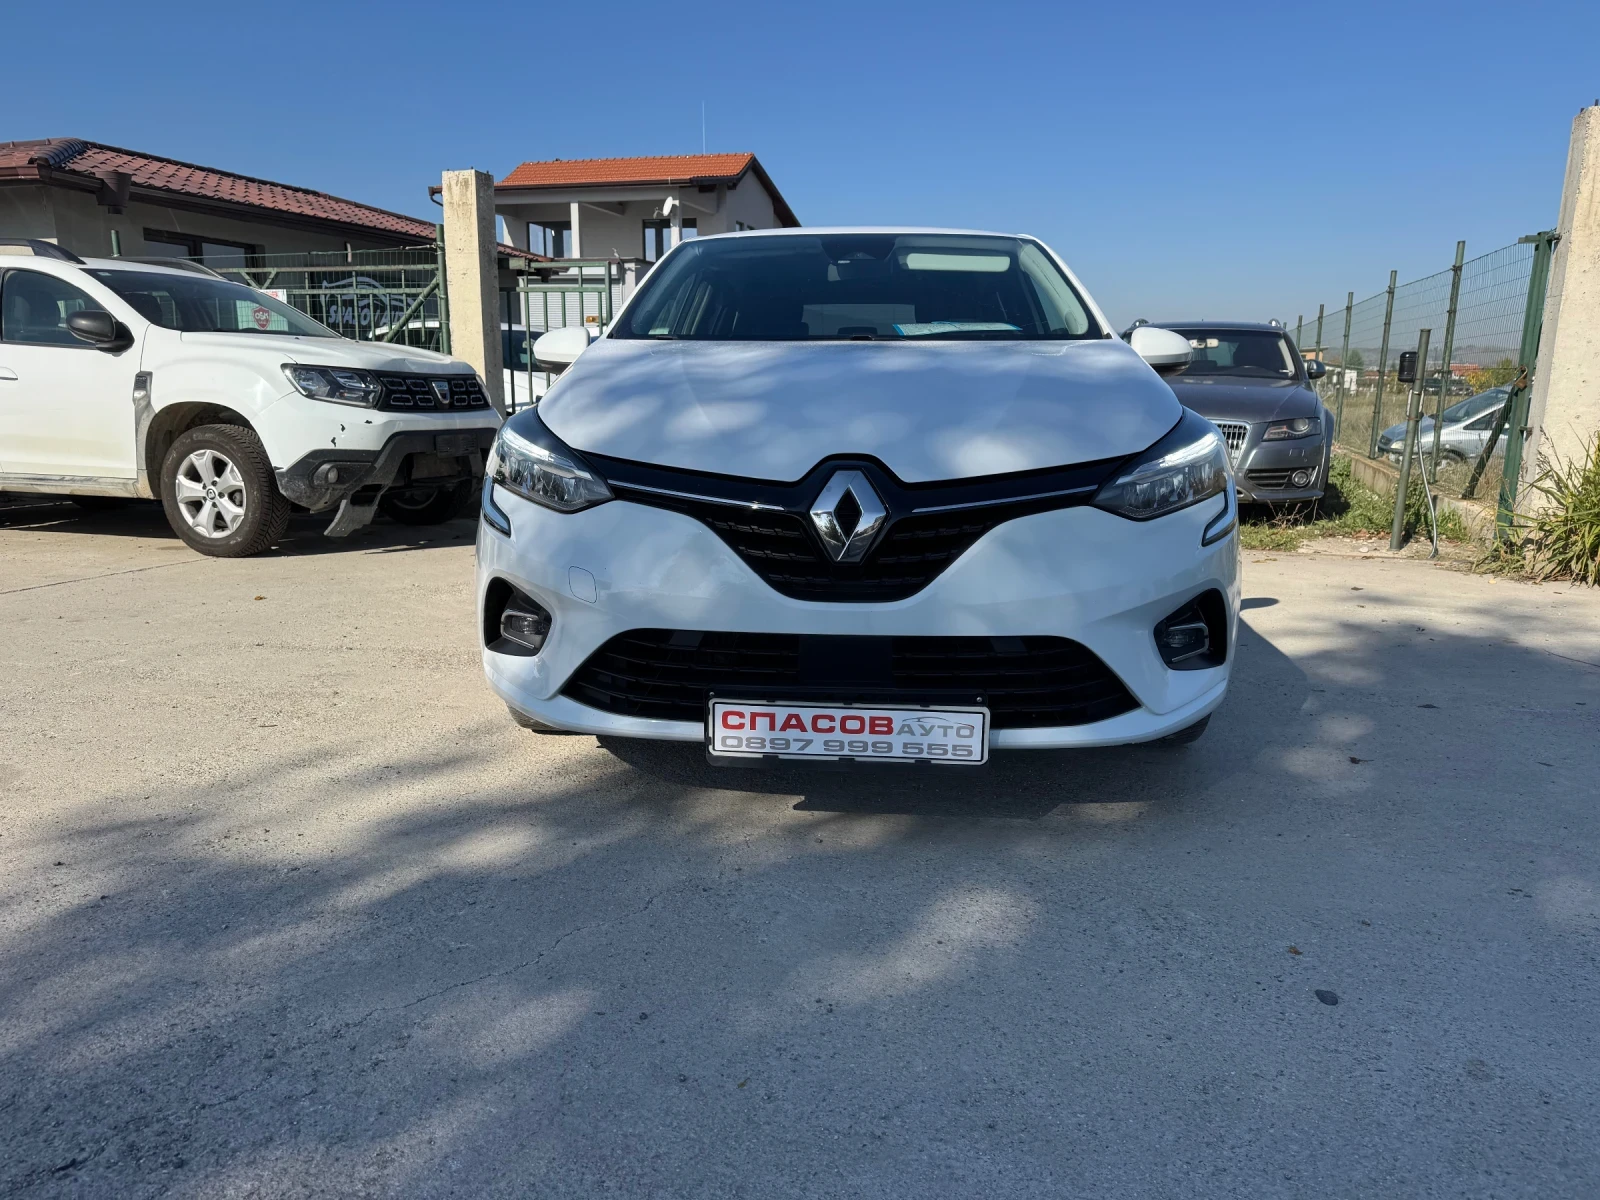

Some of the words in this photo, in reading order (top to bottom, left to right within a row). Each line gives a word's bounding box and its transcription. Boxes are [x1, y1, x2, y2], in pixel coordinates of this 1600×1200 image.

[721, 710, 894, 735] СПАСОВ
[896, 723, 975, 739] АУТО
[720, 735, 814, 751] 0897
[823, 740, 893, 754] 999
[902, 742, 974, 757] 555
